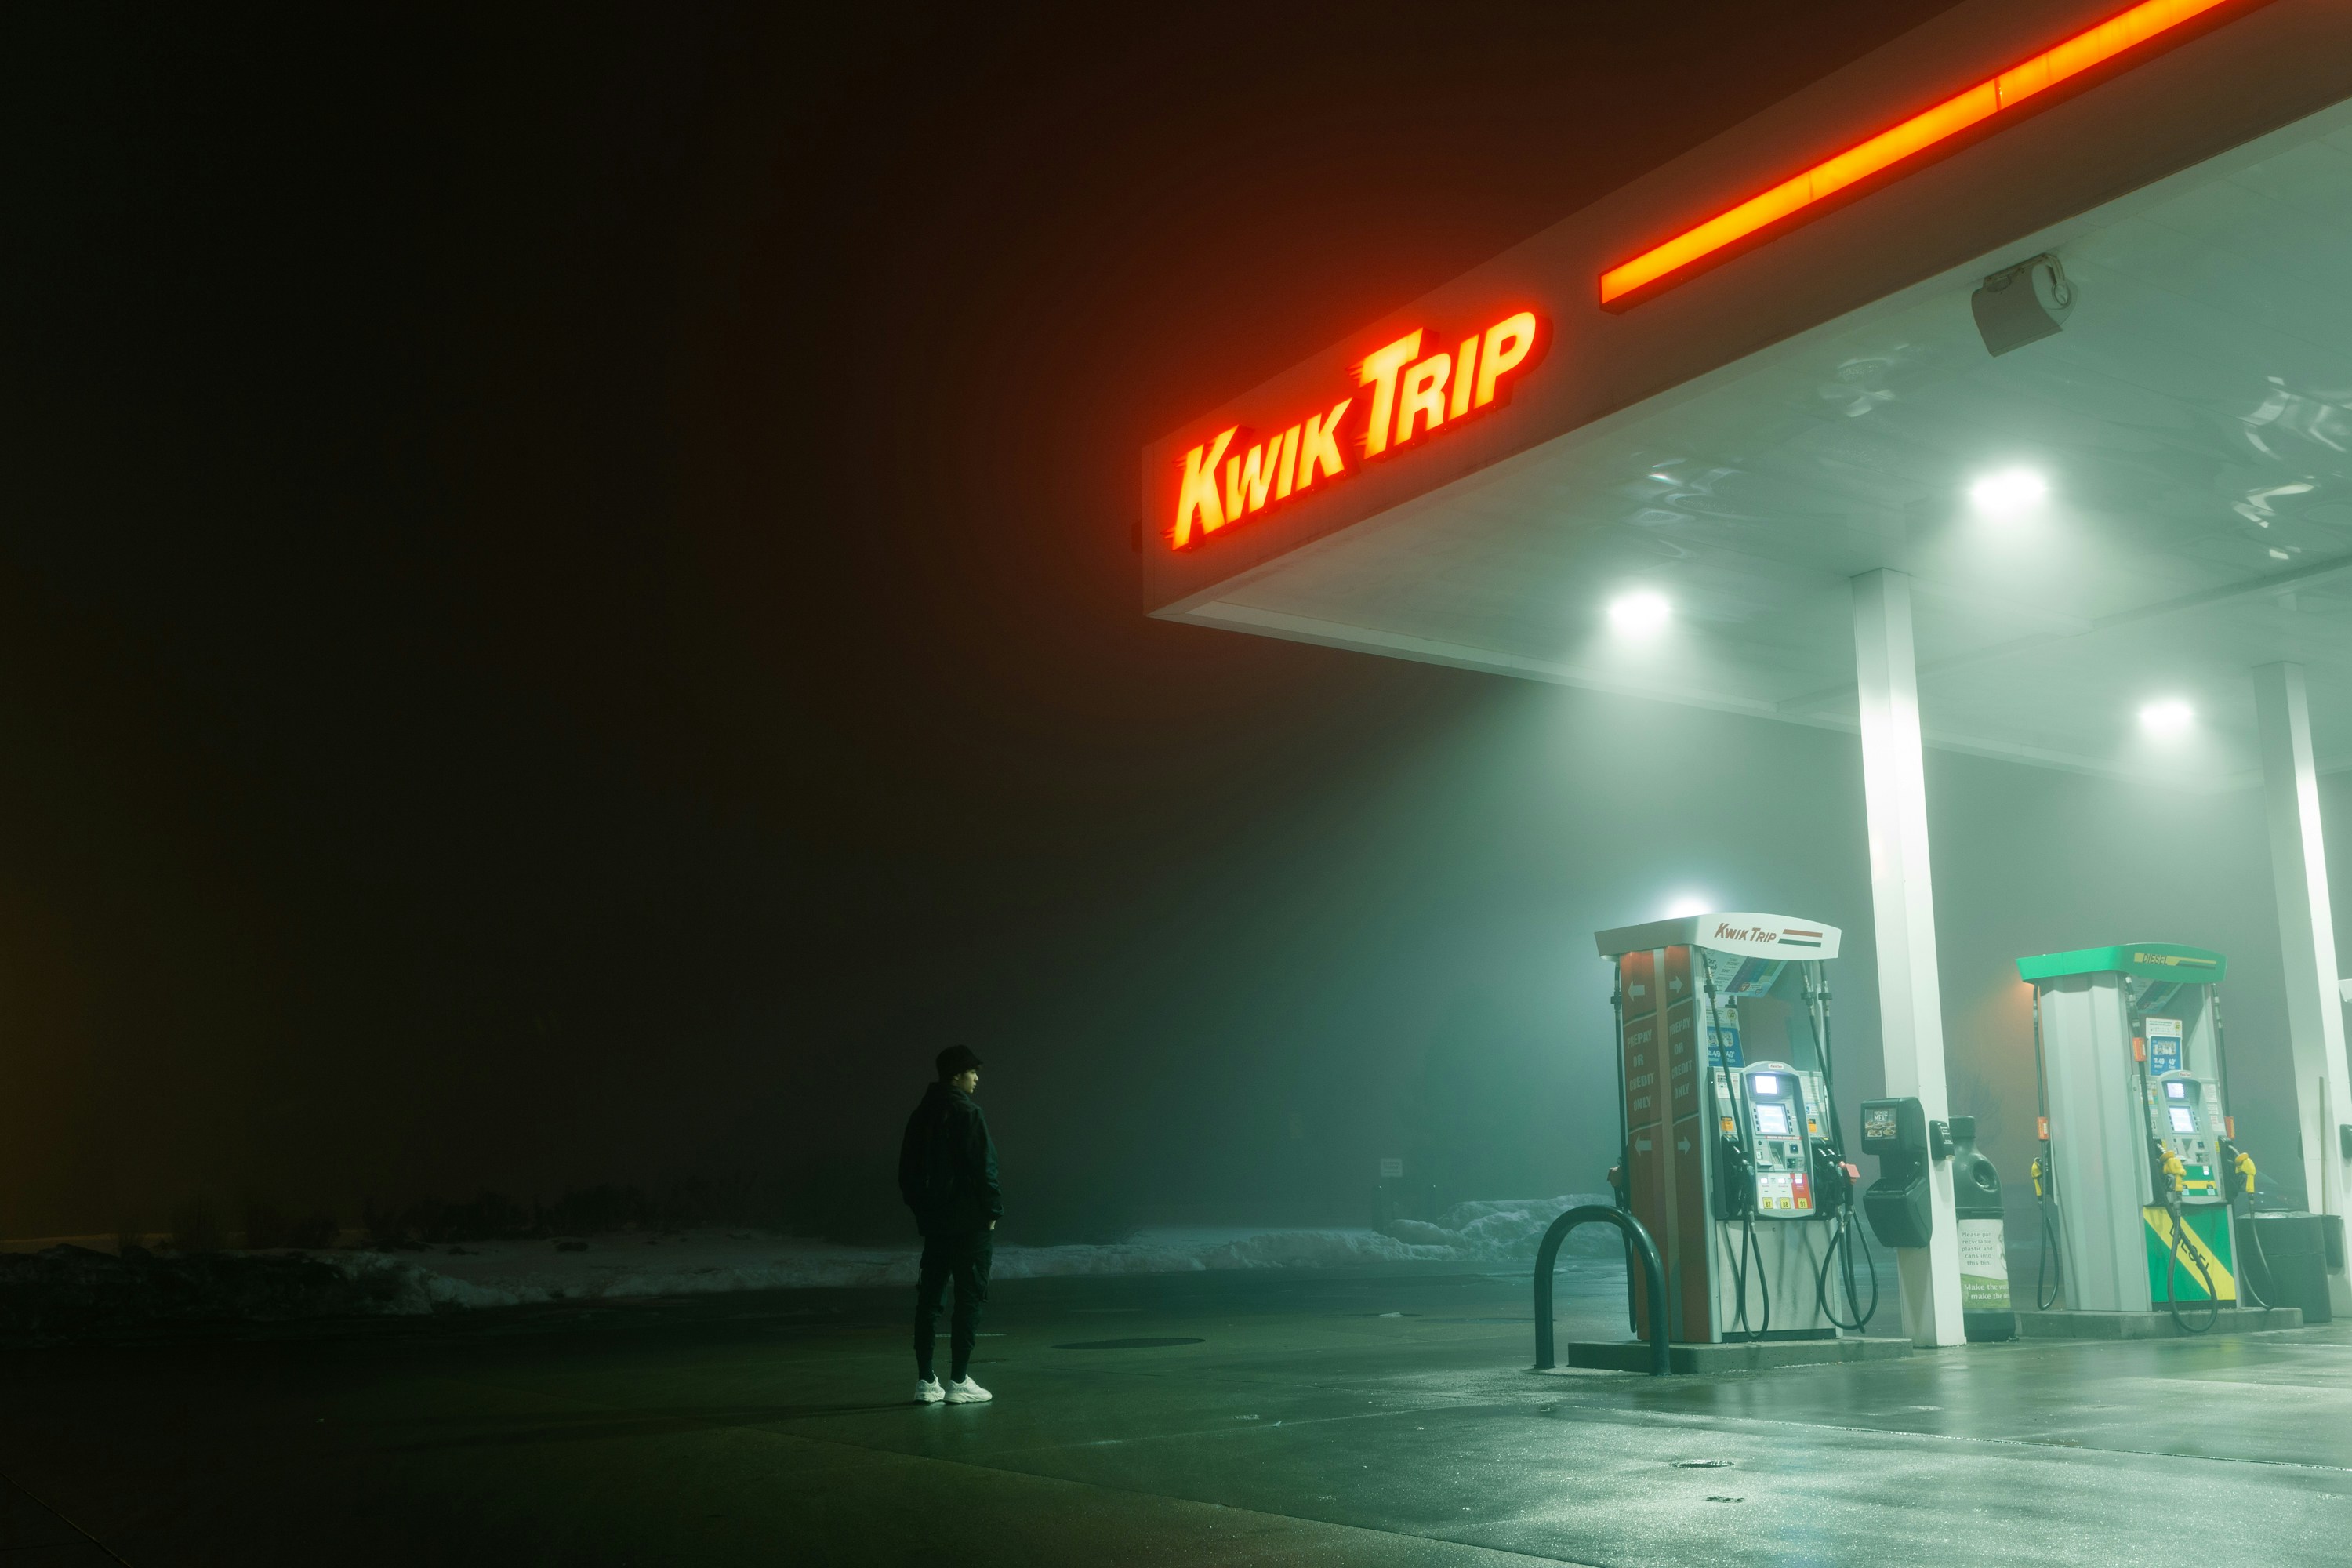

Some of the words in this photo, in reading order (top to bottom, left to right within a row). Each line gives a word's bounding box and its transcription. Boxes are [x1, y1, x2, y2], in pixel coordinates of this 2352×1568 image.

[2143, 953, 2168, 965] DIESEL
[1669, 1016, 1691, 1036] PREPAY
[1627, 1029, 1653, 1049] PREPAY
[1674, 1042, 1684, 1054] OR
[1633, 1054, 1644, 1068] OR
[1671, 1060, 1692, 1080] CREDIT
[1629, 1073, 1655, 1091] CREDIT
[1674, 1083, 1690, 1099] ONLY
[1633, 1095, 1651, 1112] ONLY
